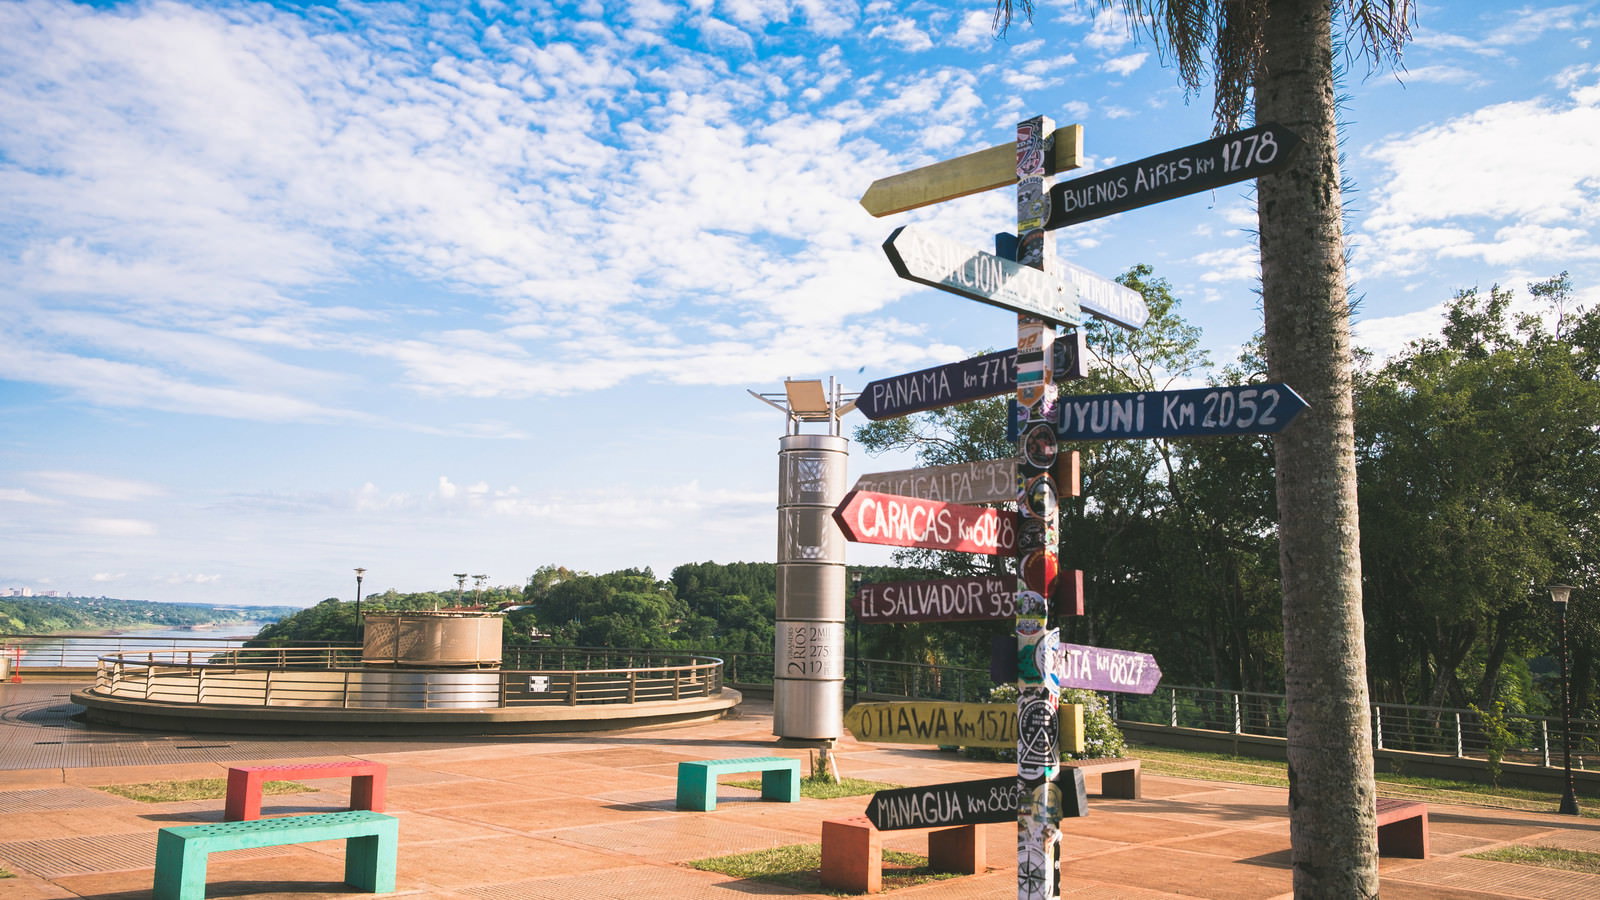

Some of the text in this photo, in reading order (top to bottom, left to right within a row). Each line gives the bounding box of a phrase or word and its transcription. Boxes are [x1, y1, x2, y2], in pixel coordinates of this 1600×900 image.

[1064, 177, 1129, 212] BUENOS
[1221, 131, 1278, 173] 1278
[1202, 389, 1281, 429] 2052
[858, 498, 952, 544] CARACAS
[973, 513, 1015, 549] 6028
[861, 589, 878, 617] EL
[881, 581, 984, 617] SALVADOR
[810, 627, 817, 642] 2
[787, 661, 806, 675] 2
[1110, 653, 1144, 686] 6827
[877, 791, 964, 829] MANAGUA
